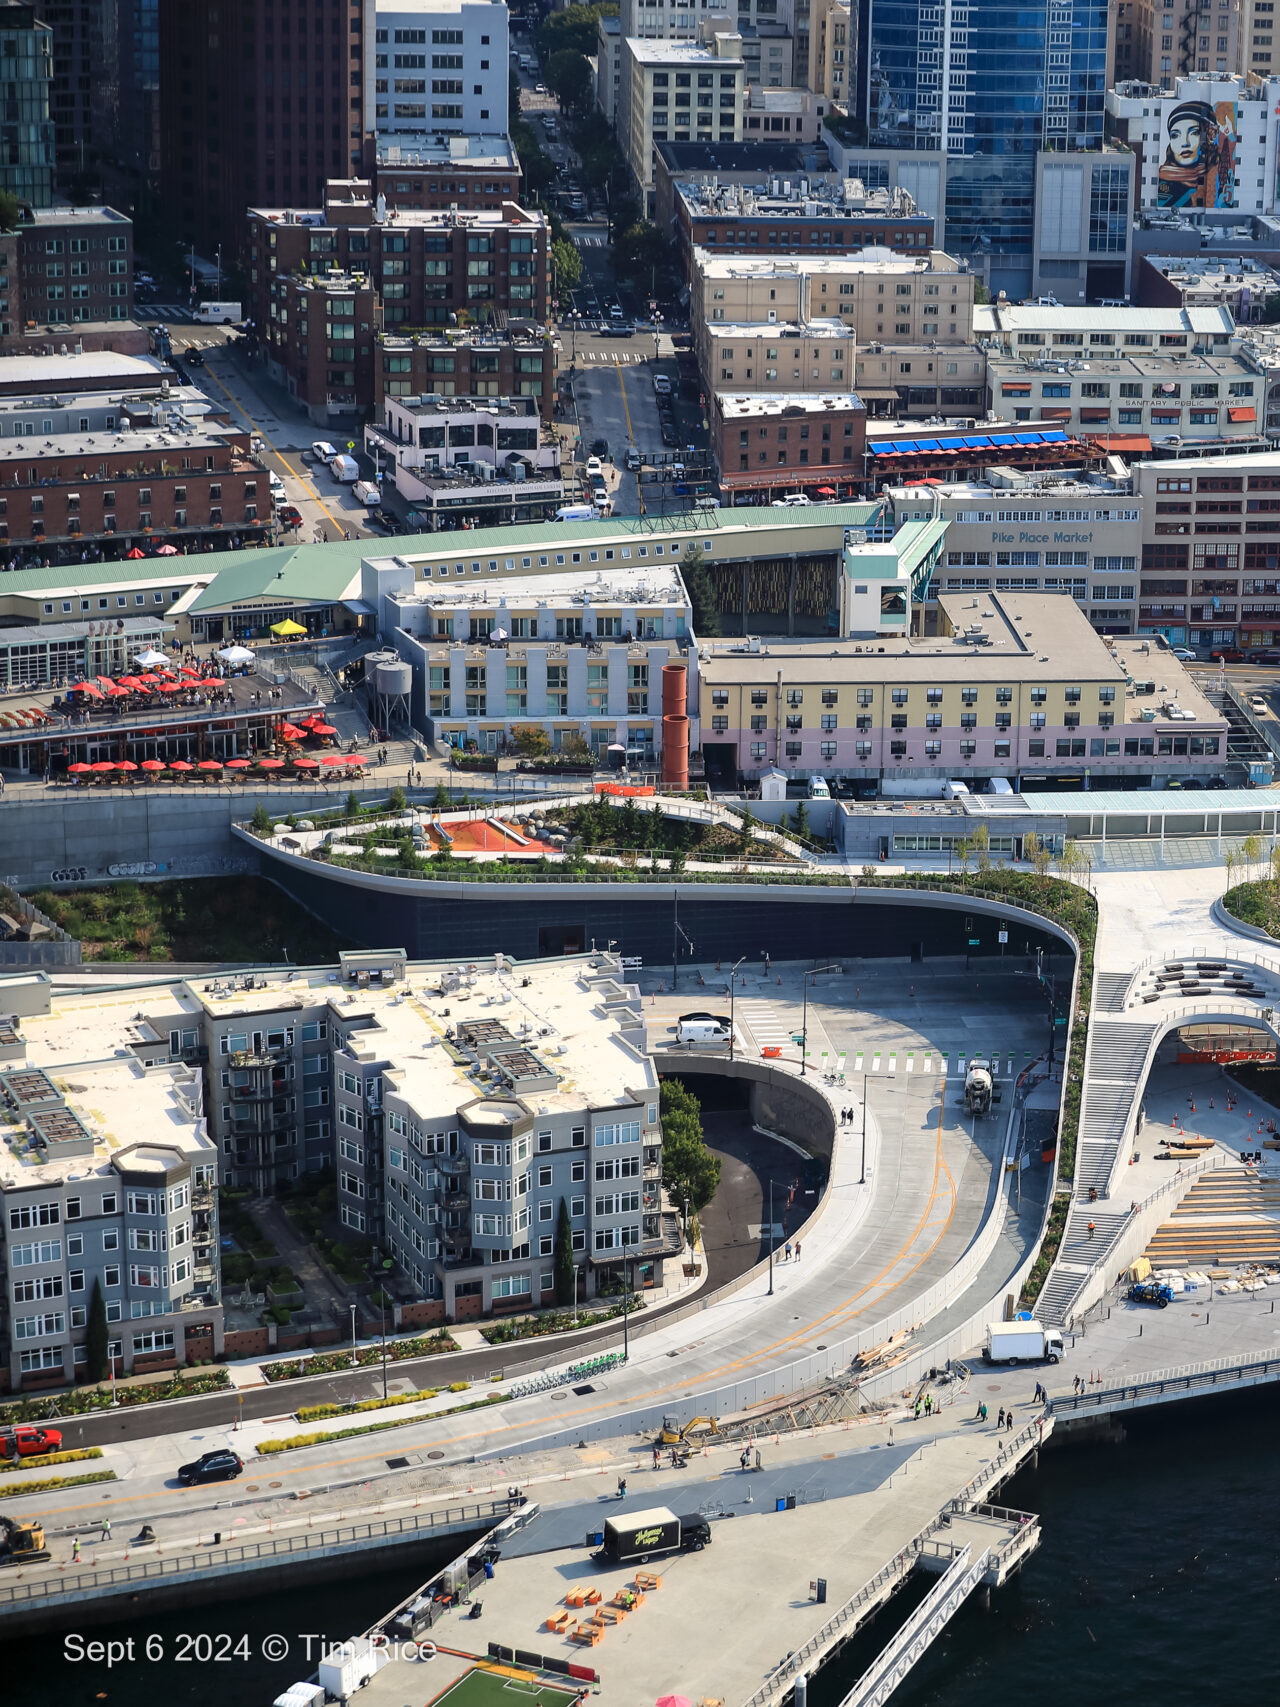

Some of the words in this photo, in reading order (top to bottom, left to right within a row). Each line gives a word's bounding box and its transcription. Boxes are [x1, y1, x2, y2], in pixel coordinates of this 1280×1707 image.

[992, 532, 1014, 542] Pike
[1019, 532, 1049, 542] Place
[1054, 532, 1093, 542] Market
